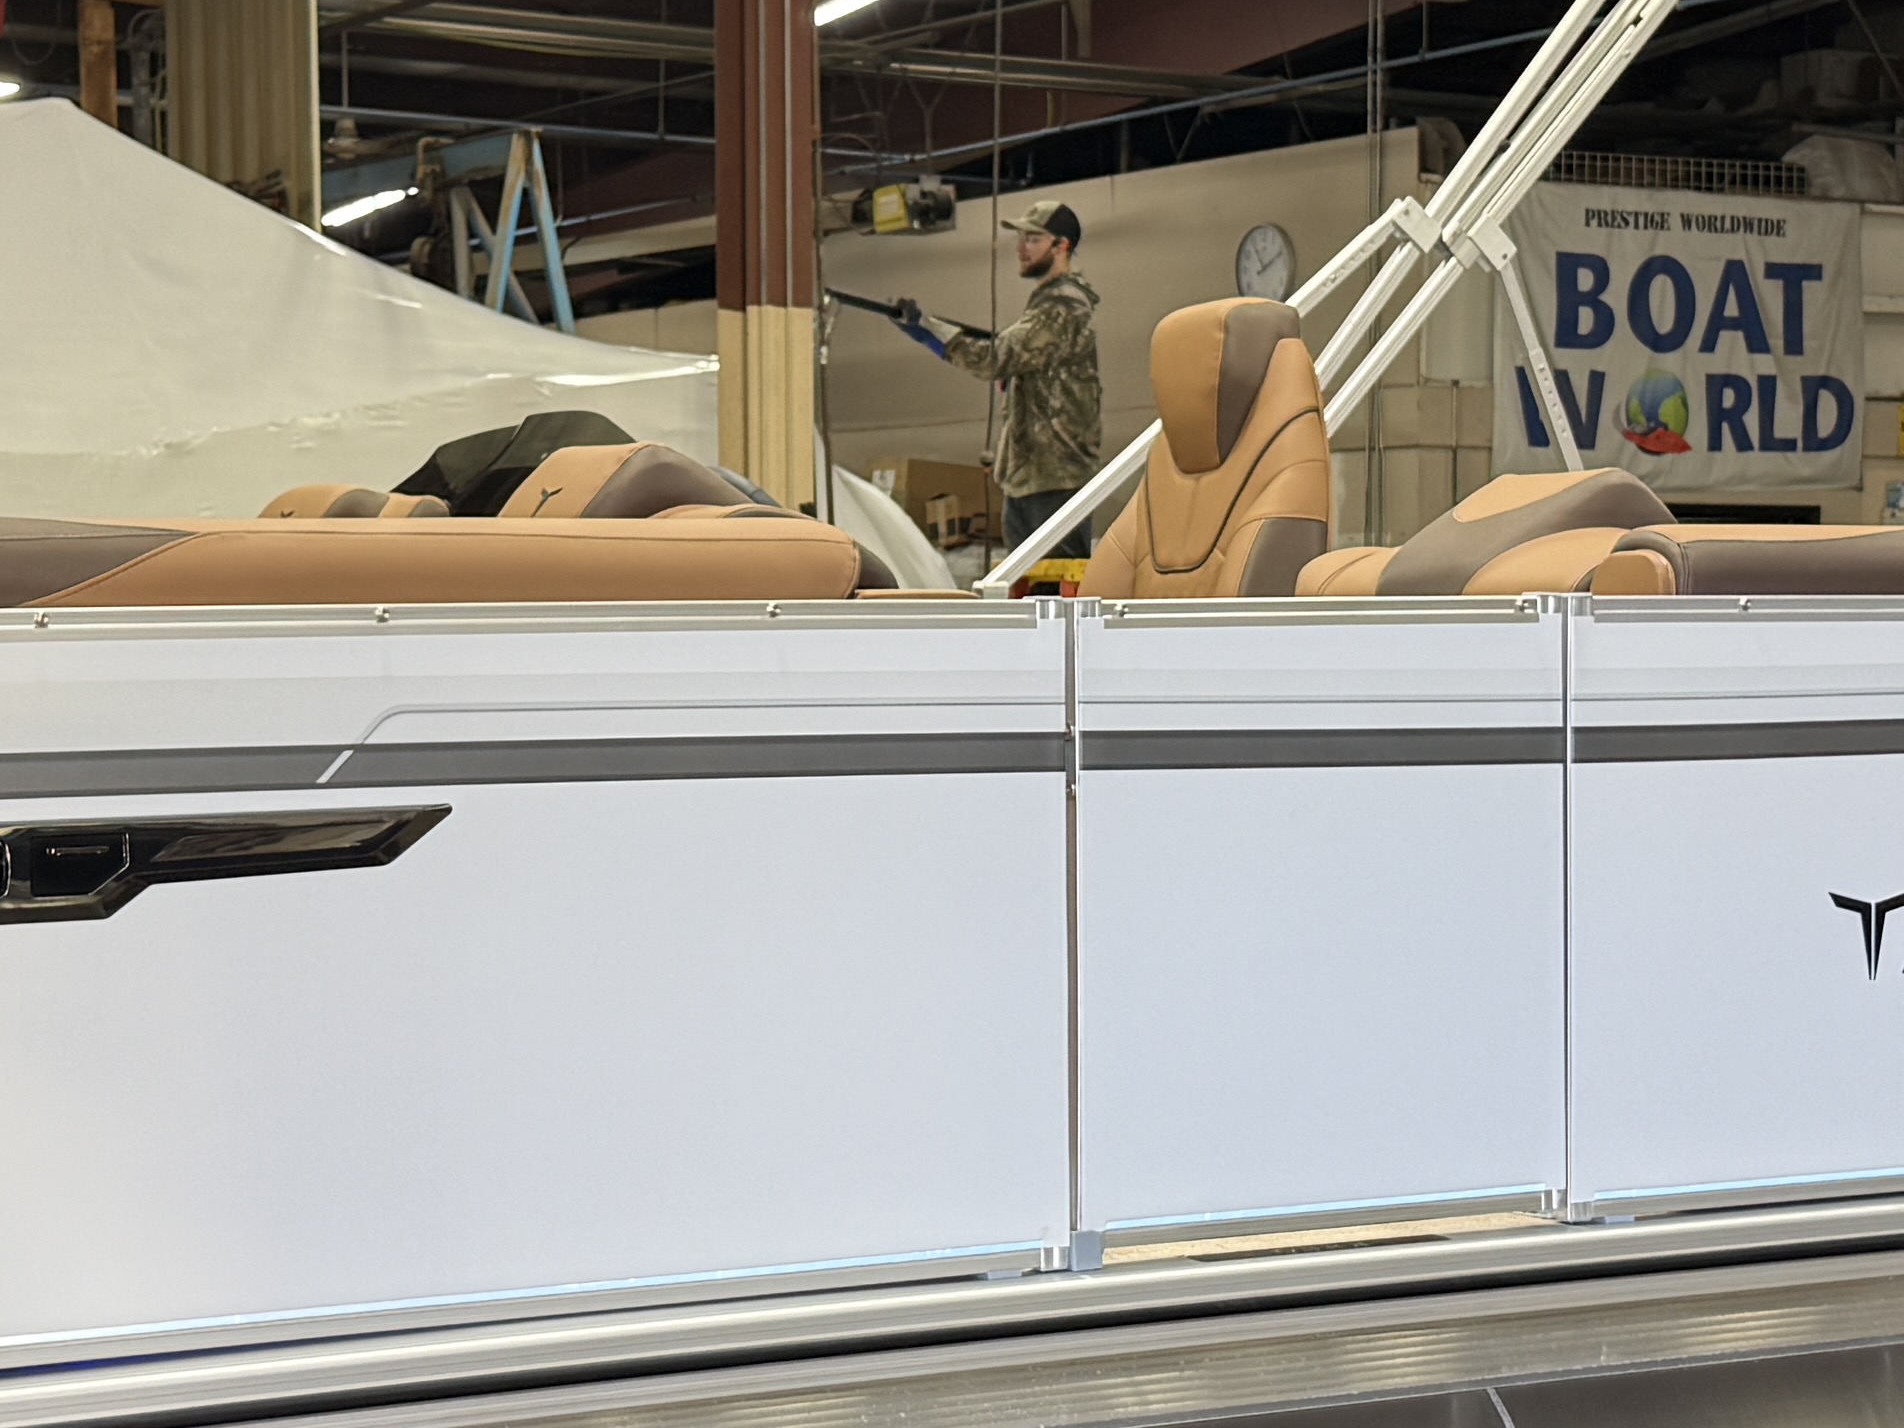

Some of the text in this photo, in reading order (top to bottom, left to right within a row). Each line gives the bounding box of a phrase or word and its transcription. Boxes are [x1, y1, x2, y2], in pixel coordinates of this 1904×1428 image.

[1584, 208, 1787, 238] PRESTIGE WORLDWIDE
[1554, 251, 1823, 356] BOAT
